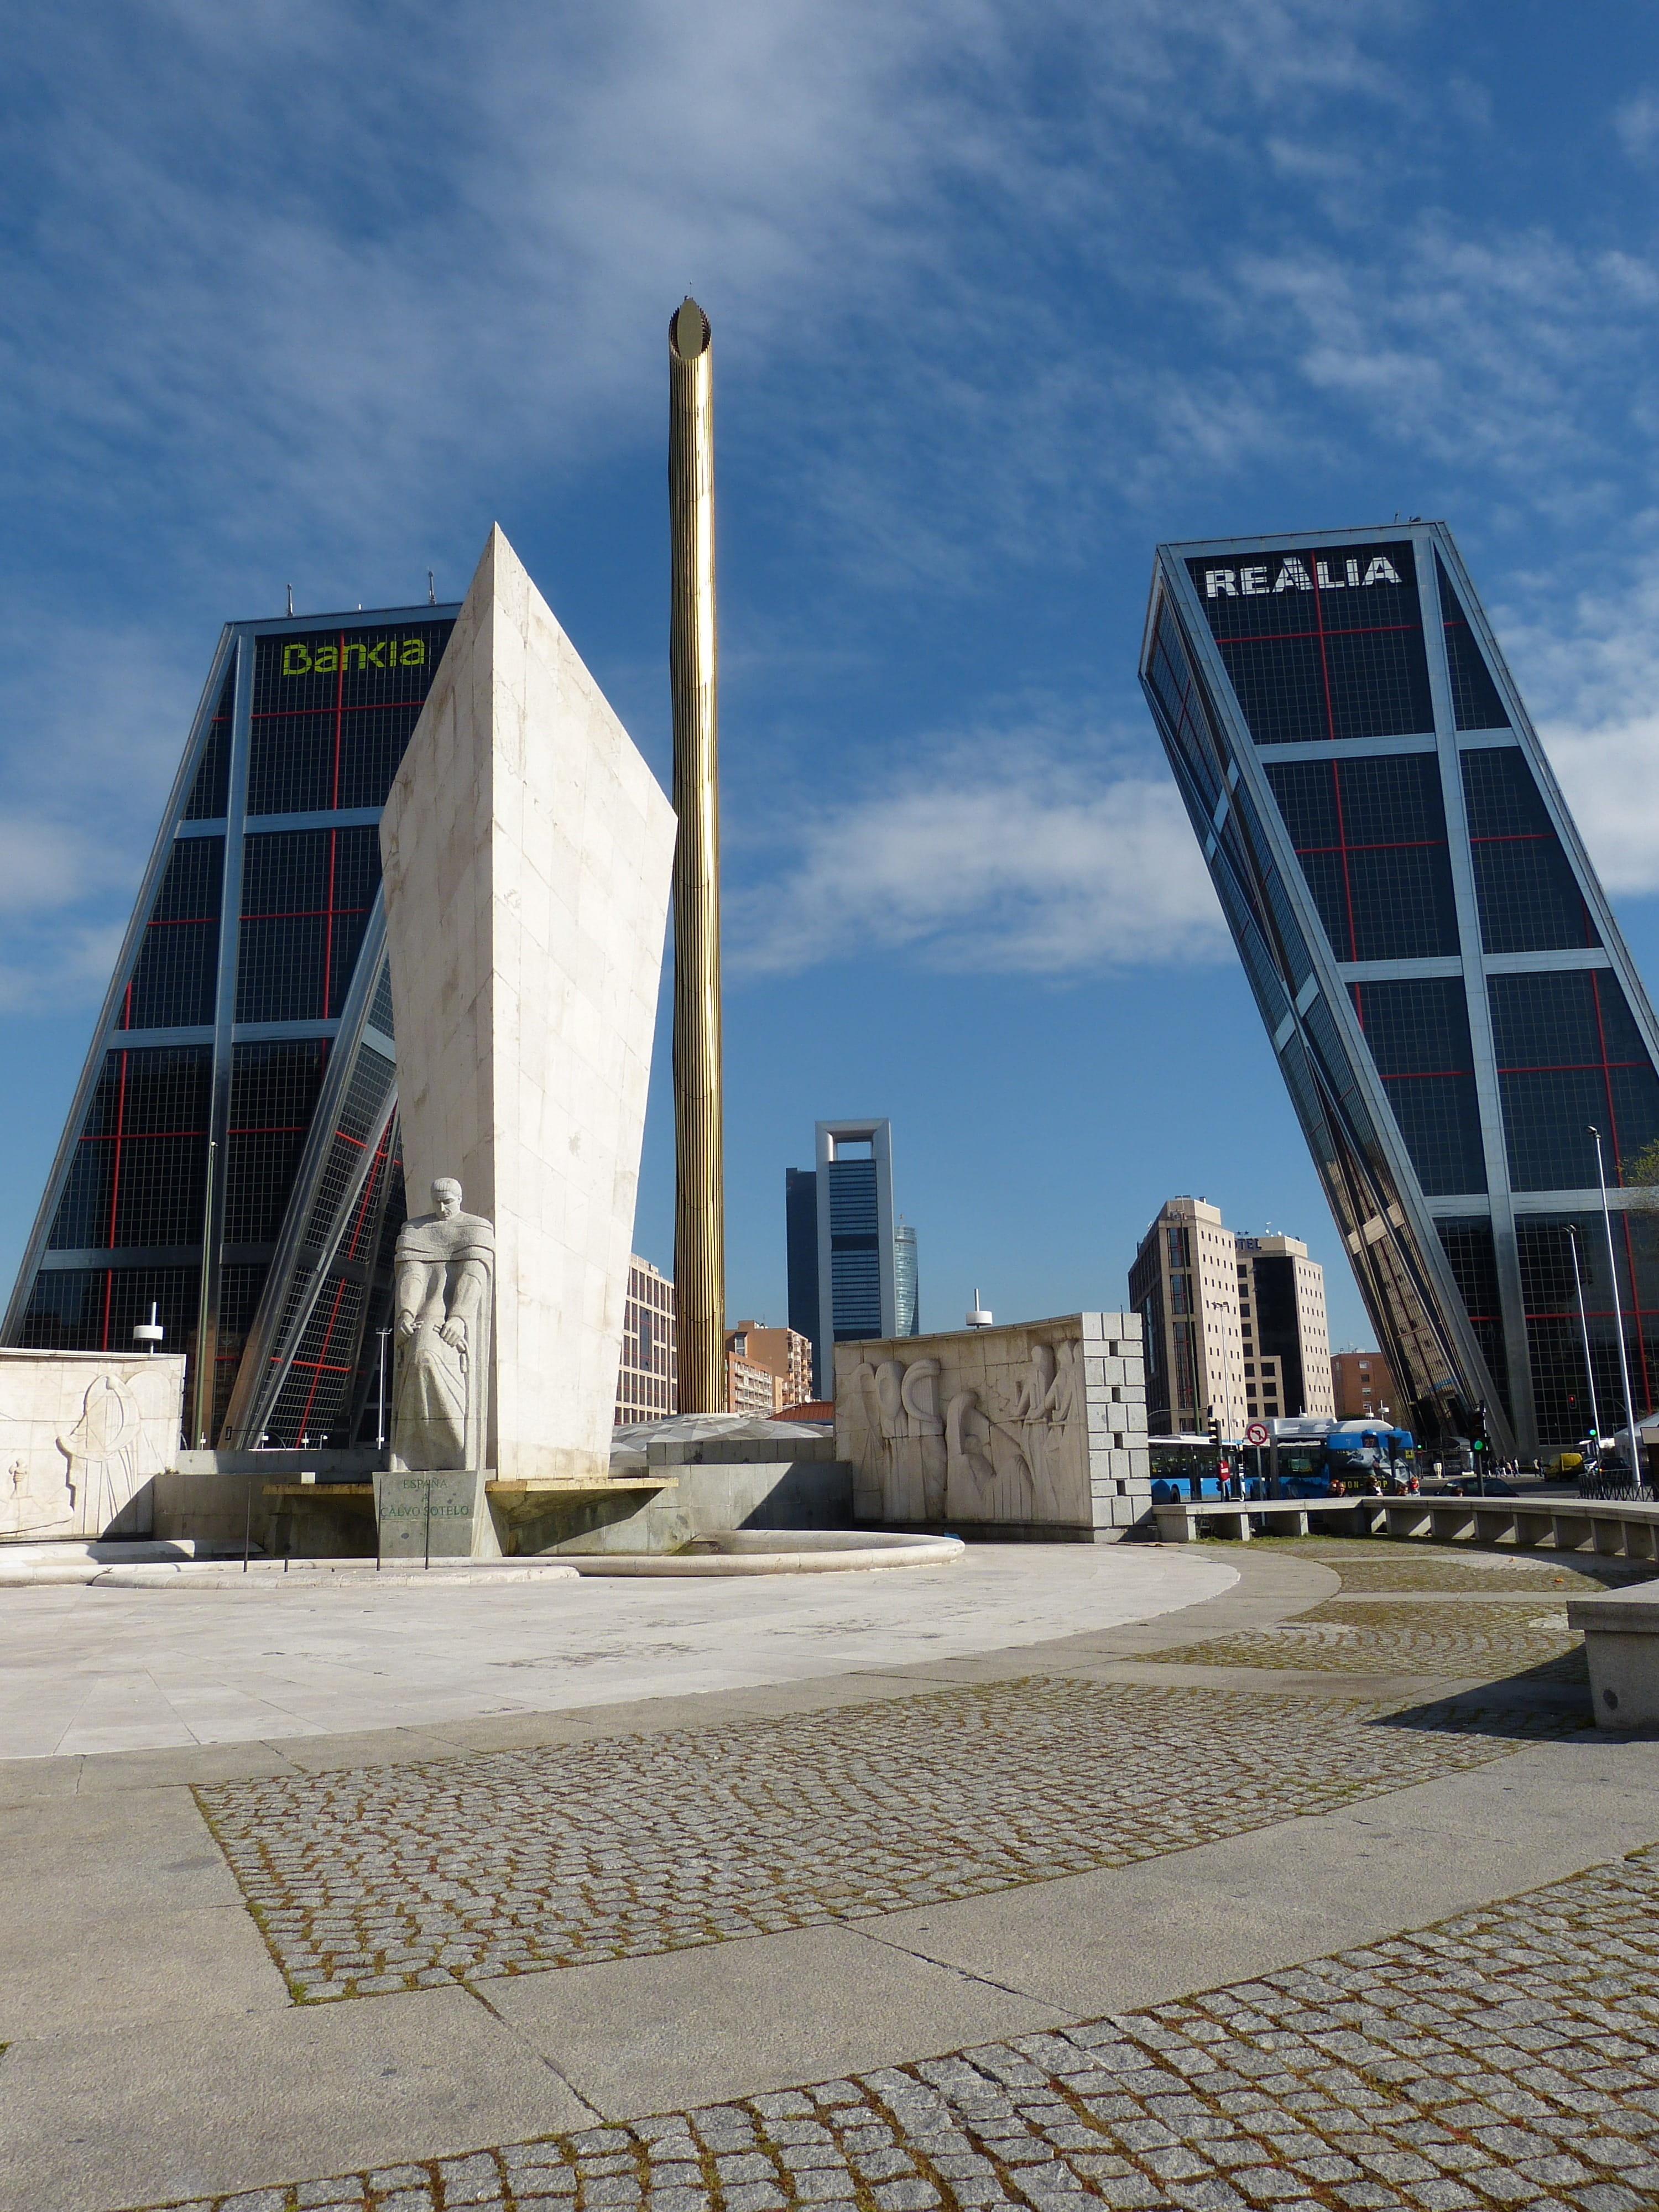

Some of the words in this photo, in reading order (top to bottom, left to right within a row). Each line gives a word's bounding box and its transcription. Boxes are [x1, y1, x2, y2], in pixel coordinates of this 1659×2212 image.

[1205, 556, 1402, 598] REALIA
[283, 638, 425, 676] Bankia
[403, 1477, 447, 1489] ESPAÑA
[380, 1506, 420, 1517] CALVO
[423, 1506, 469, 1516] SOTELO
